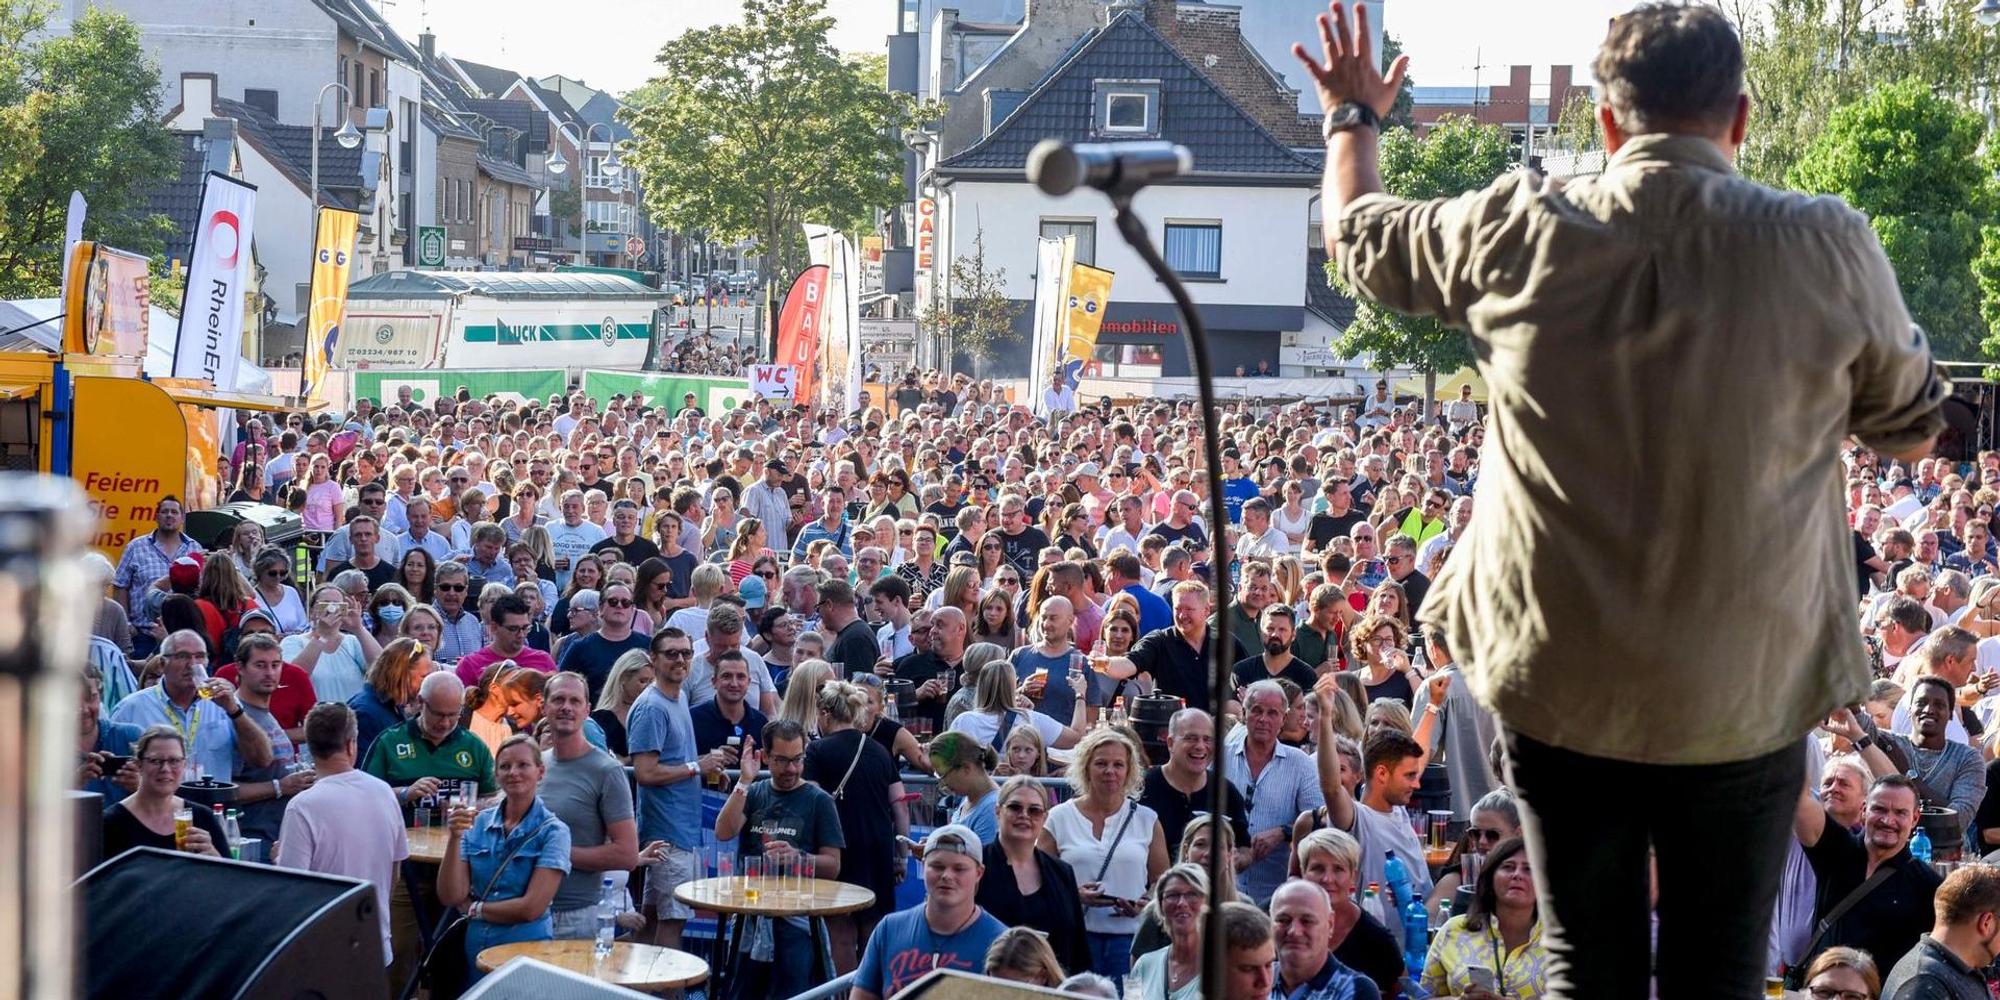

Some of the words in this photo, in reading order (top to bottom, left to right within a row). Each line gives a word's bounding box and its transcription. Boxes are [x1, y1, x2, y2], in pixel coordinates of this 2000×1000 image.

[919, 199, 935, 269] CAFE
[336, 251, 346, 265] G
[1085, 301, 1097, 313] G
[203, 279, 227, 387] RheinEn
[757, 367, 788, 385] WC
[84, 472, 160, 494] Feiern
[86, 500, 119, 520] Sie
[1007, 542, 1018, 553] H
[1022, 556, 1034, 569] T
